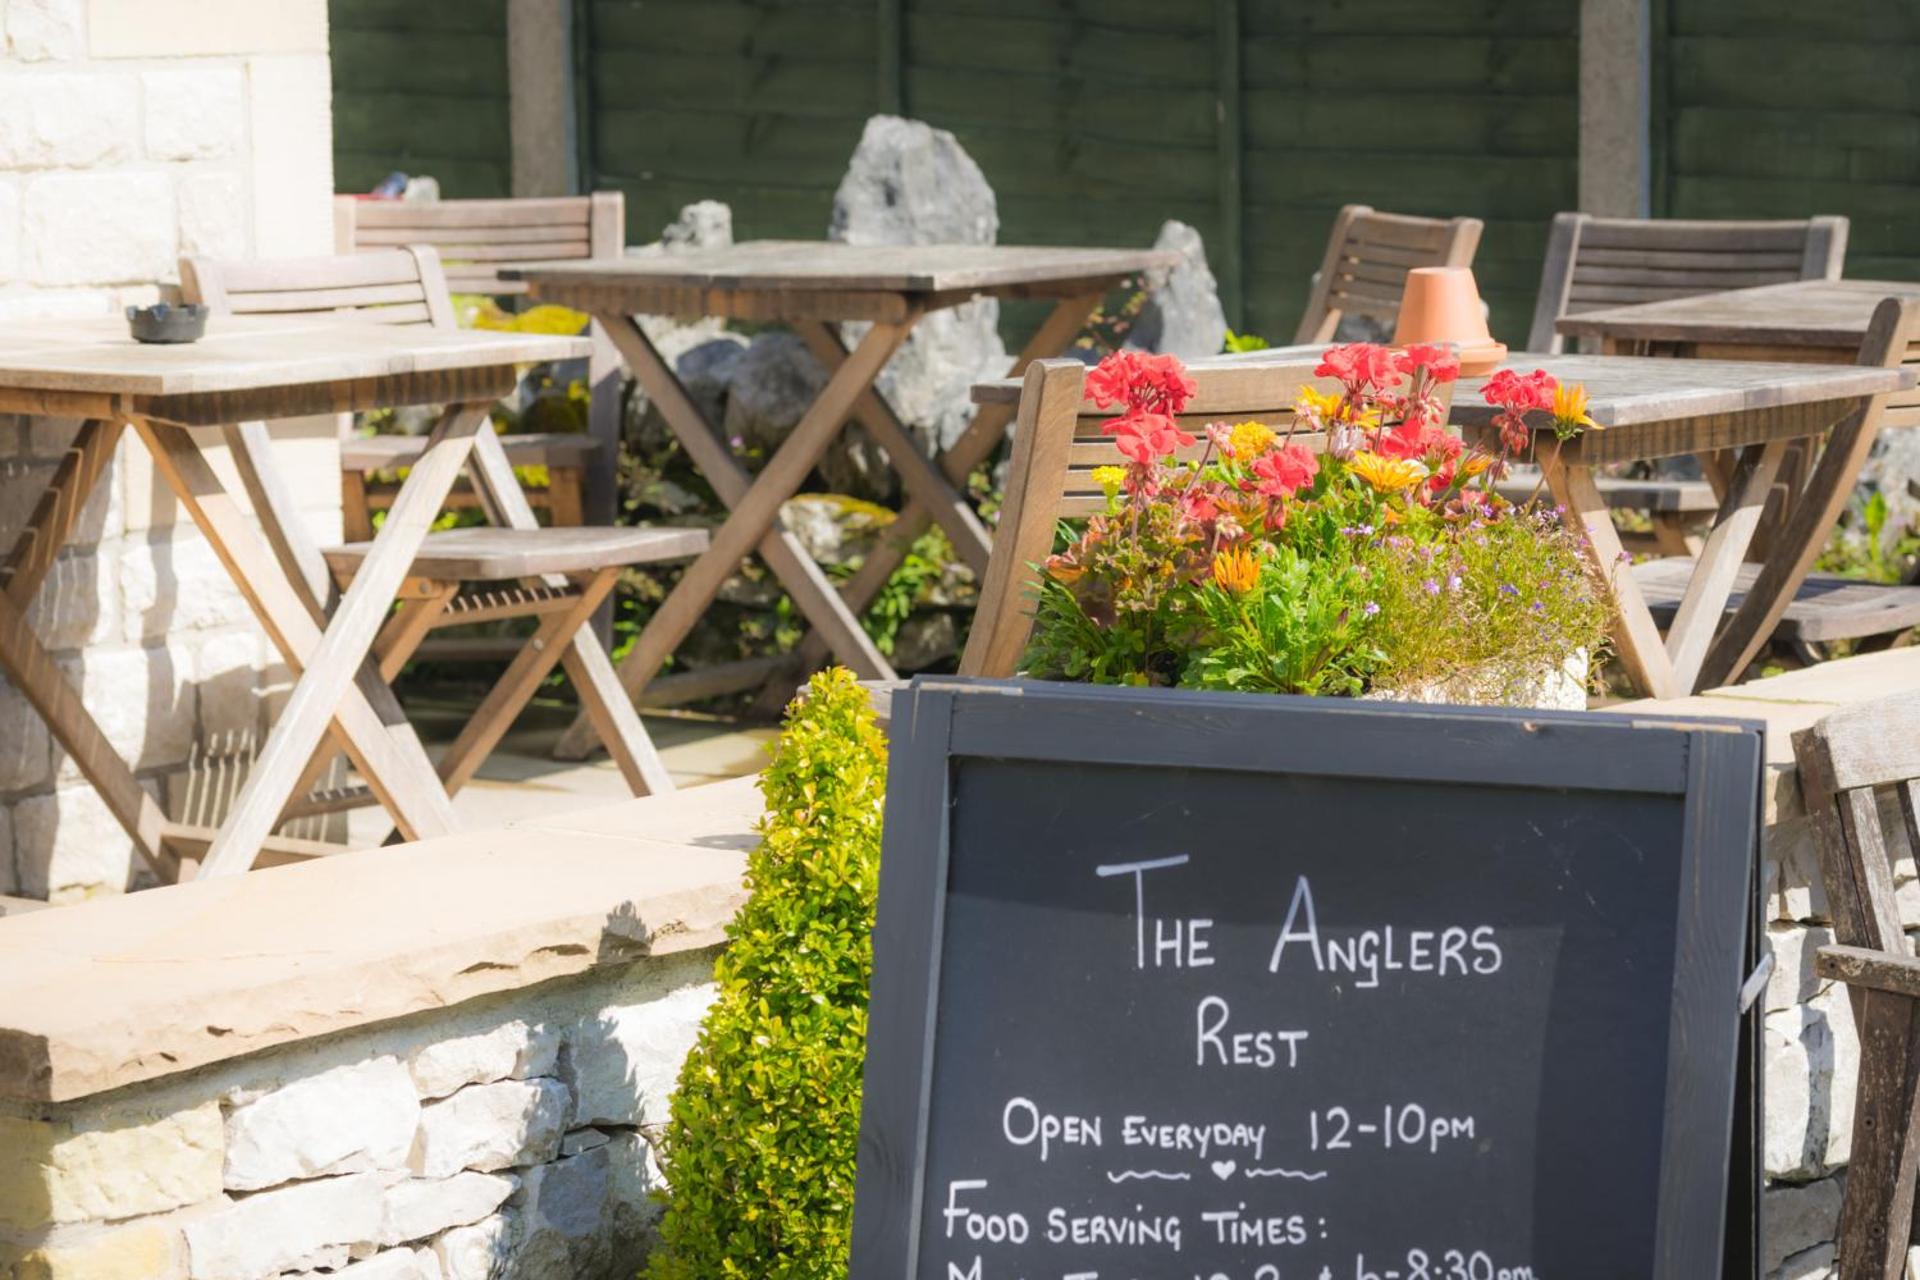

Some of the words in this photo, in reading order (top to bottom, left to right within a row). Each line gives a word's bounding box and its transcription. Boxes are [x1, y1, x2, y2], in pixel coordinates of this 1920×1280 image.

[1096, 854, 1216, 970] THE
[1268, 876, 1503, 989] ANGLERS
[1196, 995, 1309, 1068] REST
[1002, 1096, 1103, 1163] OPEN
[1121, 1114, 1267, 1161] EVERYDAY
[942, 1178, 1030, 1245] FOOD
[1046, 1202, 1183, 1252] SERVING
